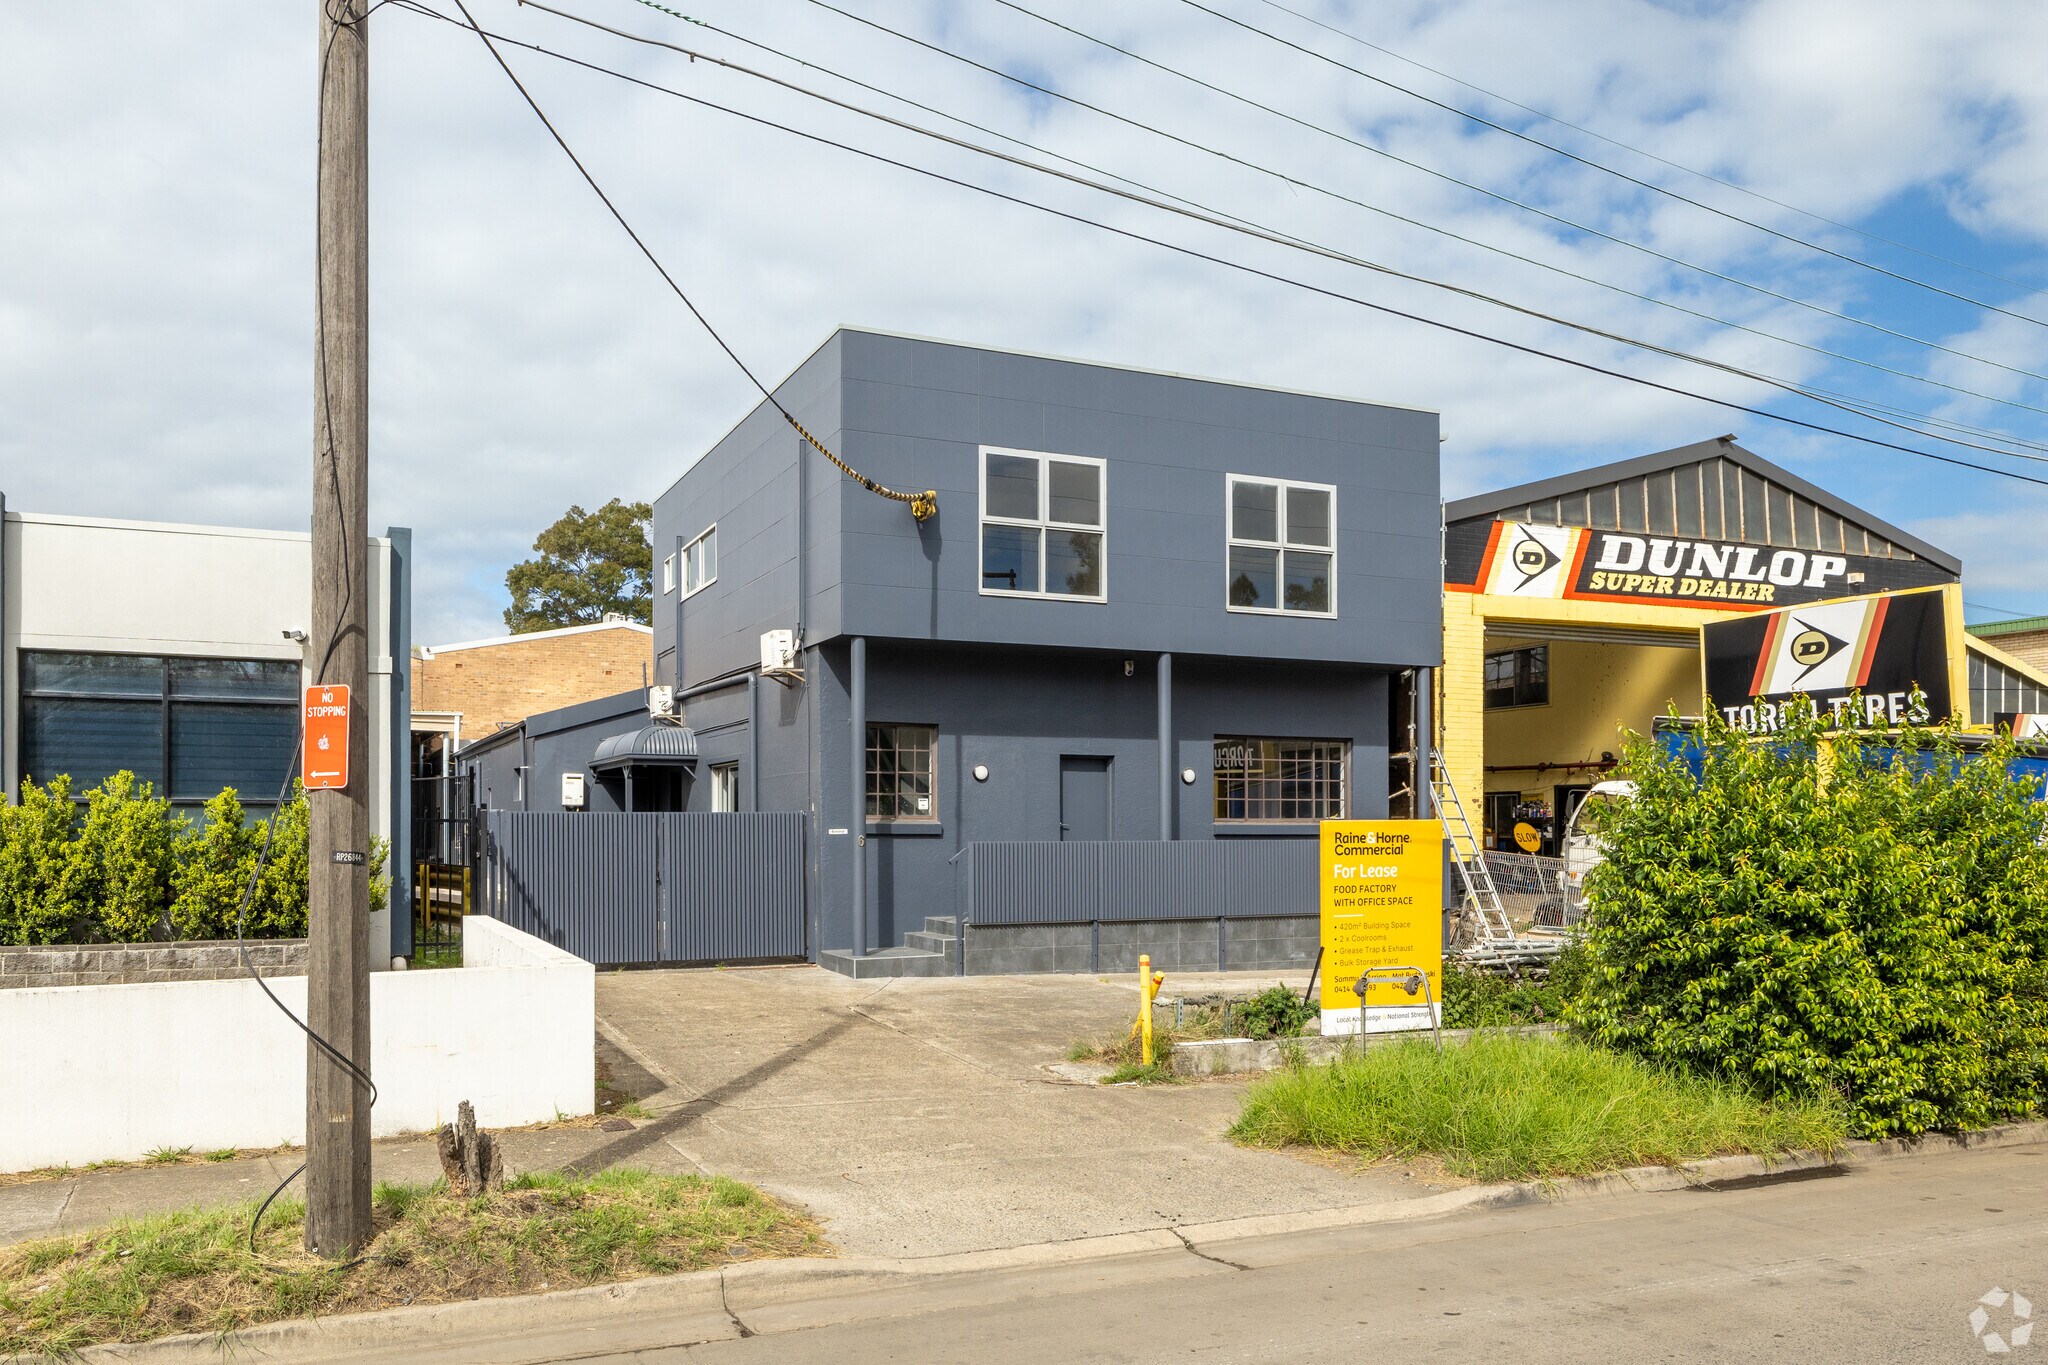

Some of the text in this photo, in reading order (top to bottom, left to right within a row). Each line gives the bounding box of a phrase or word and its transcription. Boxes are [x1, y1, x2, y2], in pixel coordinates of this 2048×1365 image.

[1594, 534, 1846, 588] DUNLOP
[1589, 571, 1775, 602] SUPER DEALER
[321, 692, 334, 703] NO
[307, 705, 346, 717] STOPPING
[1515, 832, 1538, 842] SLOW
[1334, 844, 1404, 855] Commercial
[1333, 864, 1398, 878] For Lease
[1333, 884, 1397, 893] FOOD FACTORY
[1333, 896, 1413, 906] WITH OFFICE SPACE
[1363, 922, 1390, 930] Building
[1391, 921, 1411, 930] Space
[1351, 934, 1387, 942] Coolrooms
[1365, 946, 1380, 954] Trap
[1388, 945, 1413, 953] Exhaust
[1355, 959, 1382, 968] Storage
[1383, 957, 1399, 965] Yard
[1352, 1014, 1381, 1022] Knoledge
[1411, 1010, 1431, 1019] Strengt
